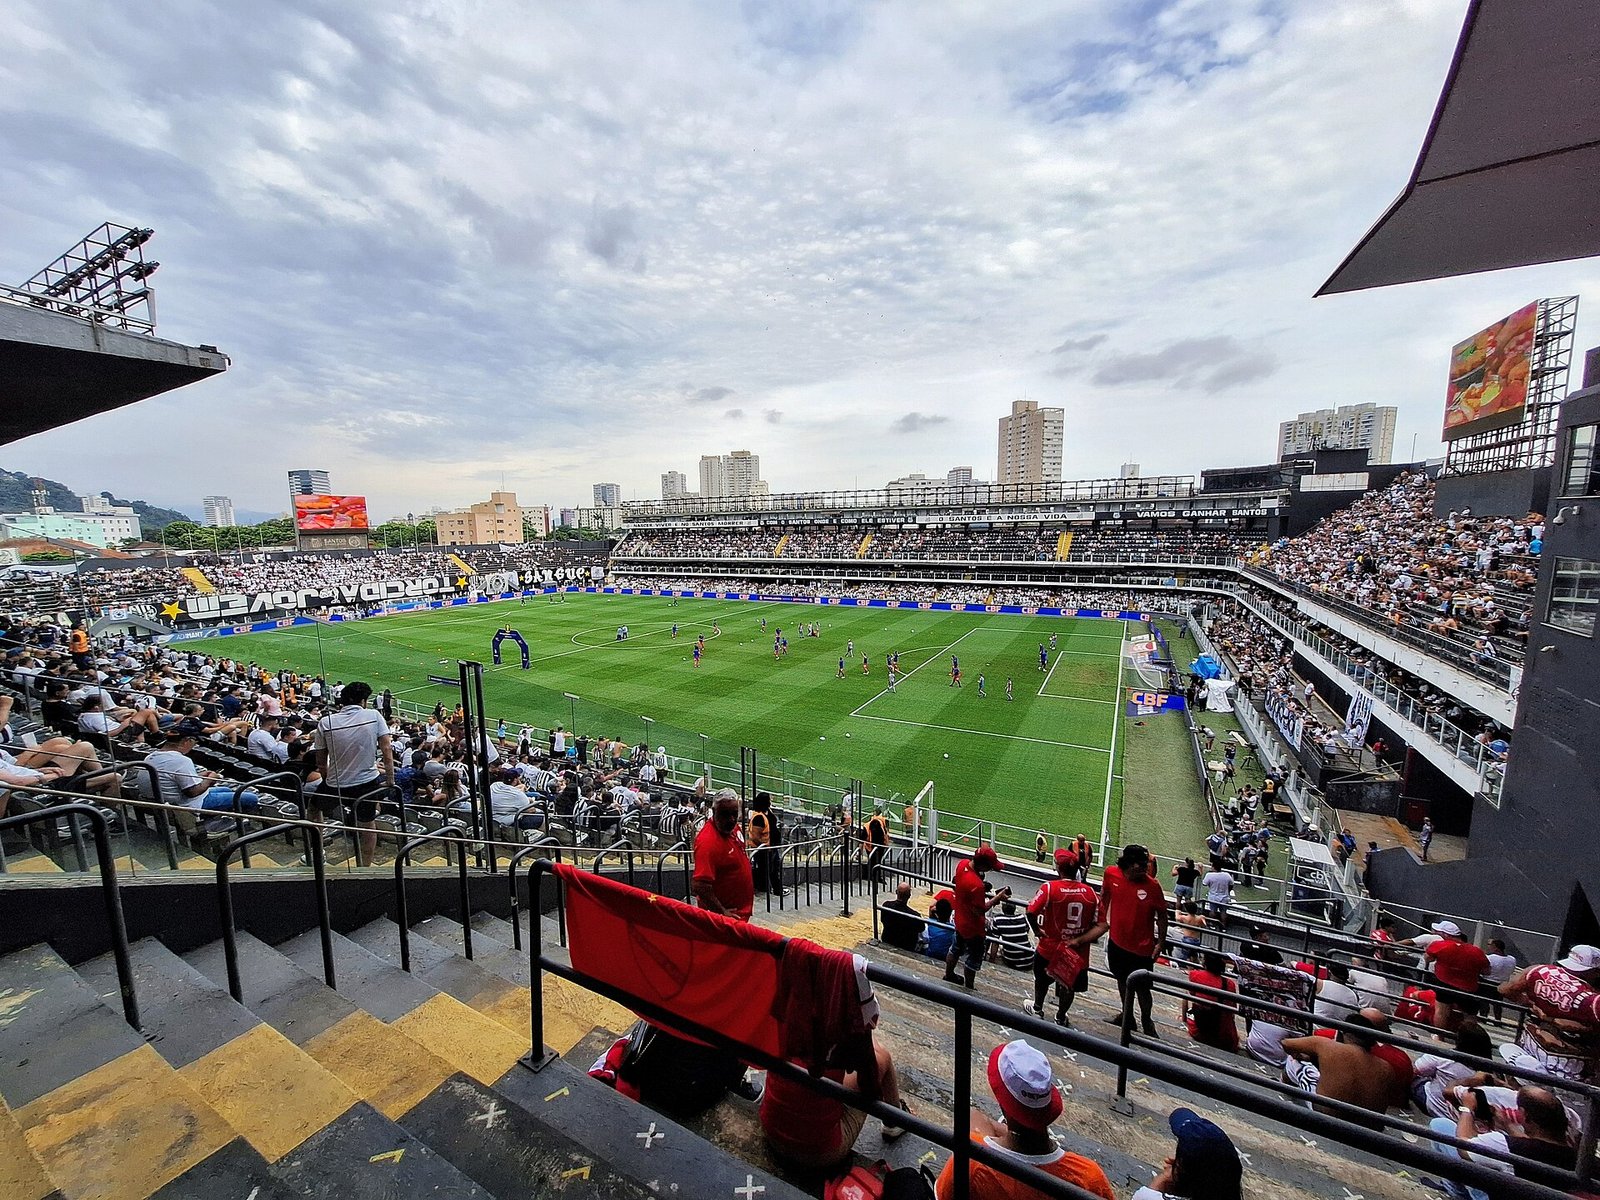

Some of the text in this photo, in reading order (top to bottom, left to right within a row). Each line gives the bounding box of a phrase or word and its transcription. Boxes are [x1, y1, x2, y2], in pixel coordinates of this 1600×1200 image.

[524, 568, 585, 583] SANGUE
[340, 576, 455, 602] TORCIDA
[186, 589, 319, 619] JOVEM
[233, 625, 253, 634] CBF
[276, 618, 296, 626] CBF
[1131, 692, 1168, 707] CBF
[1067, 902, 1083, 929] 9
[1534, 980, 1572, 1010] 1994
